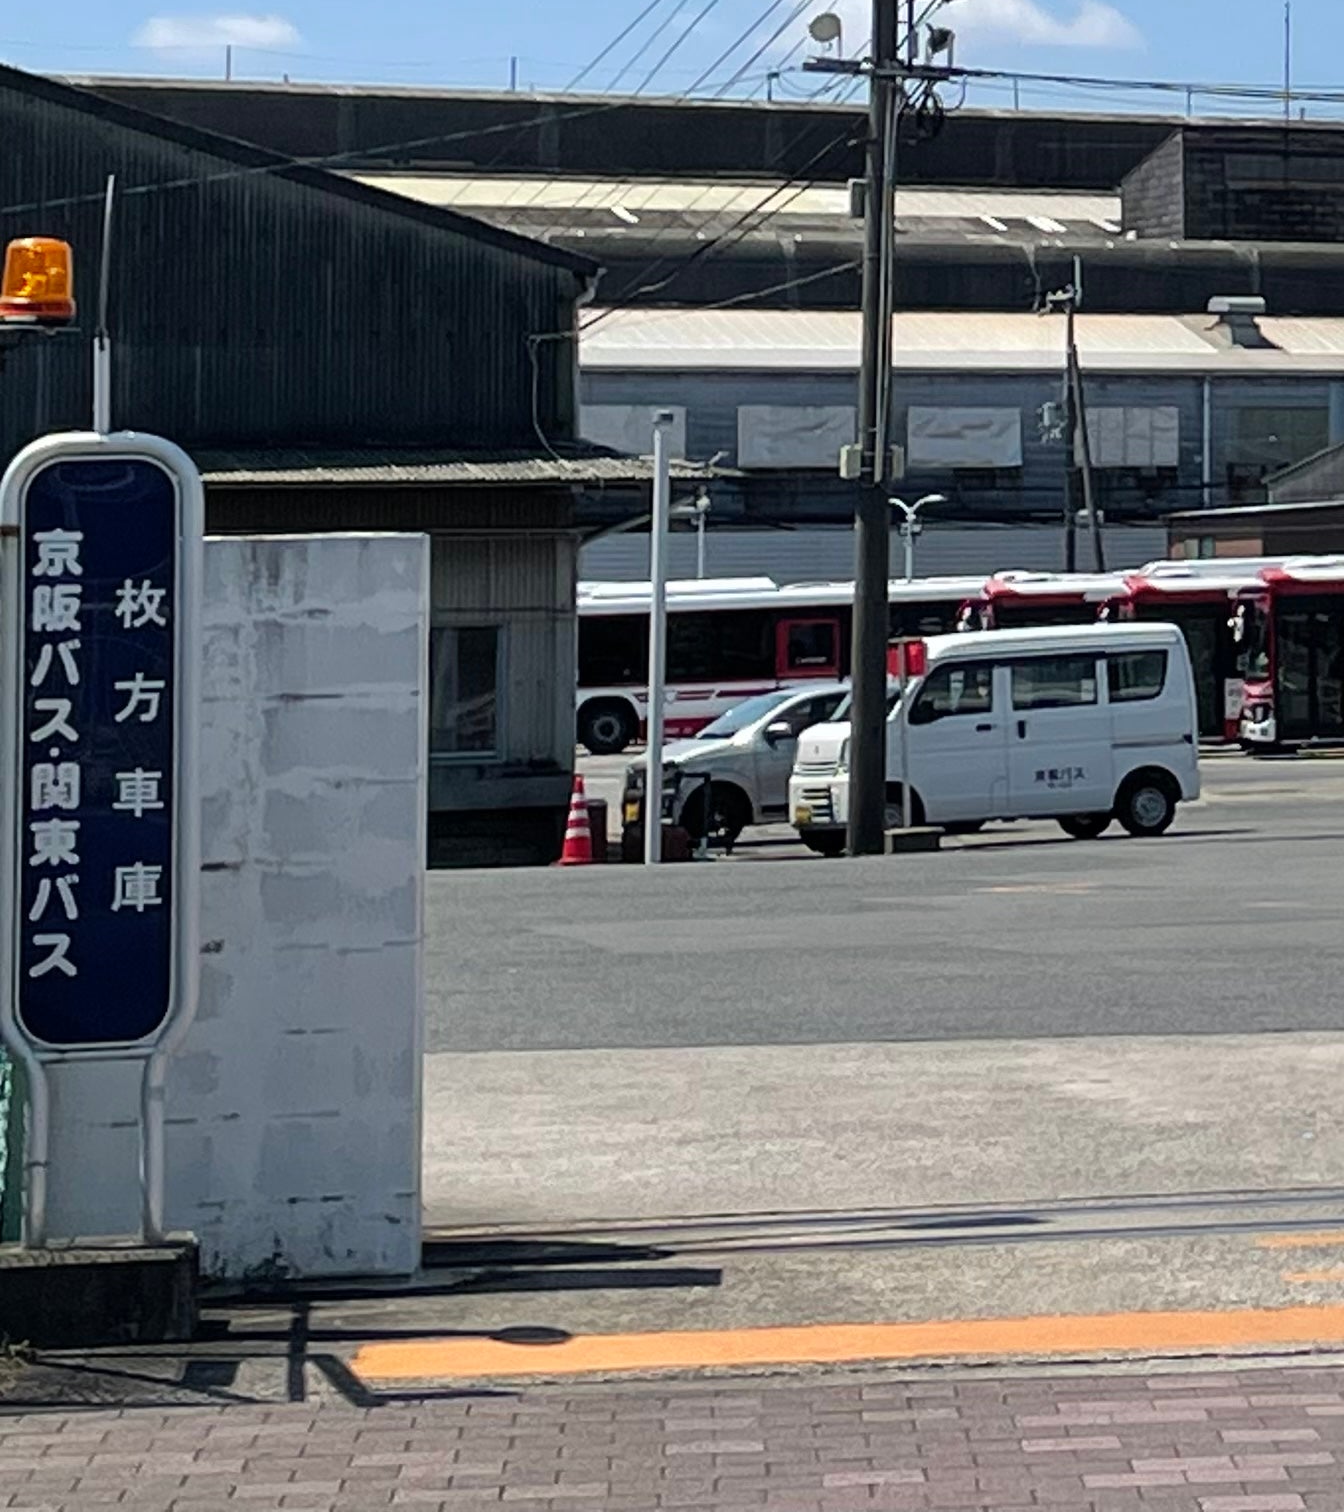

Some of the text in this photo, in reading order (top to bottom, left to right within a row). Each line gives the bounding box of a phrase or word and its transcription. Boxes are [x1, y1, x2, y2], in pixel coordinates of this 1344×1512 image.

[29, 528, 83, 978] 京阪バス・関東バス
[112, 579, 166, 912] 枚方車庫
